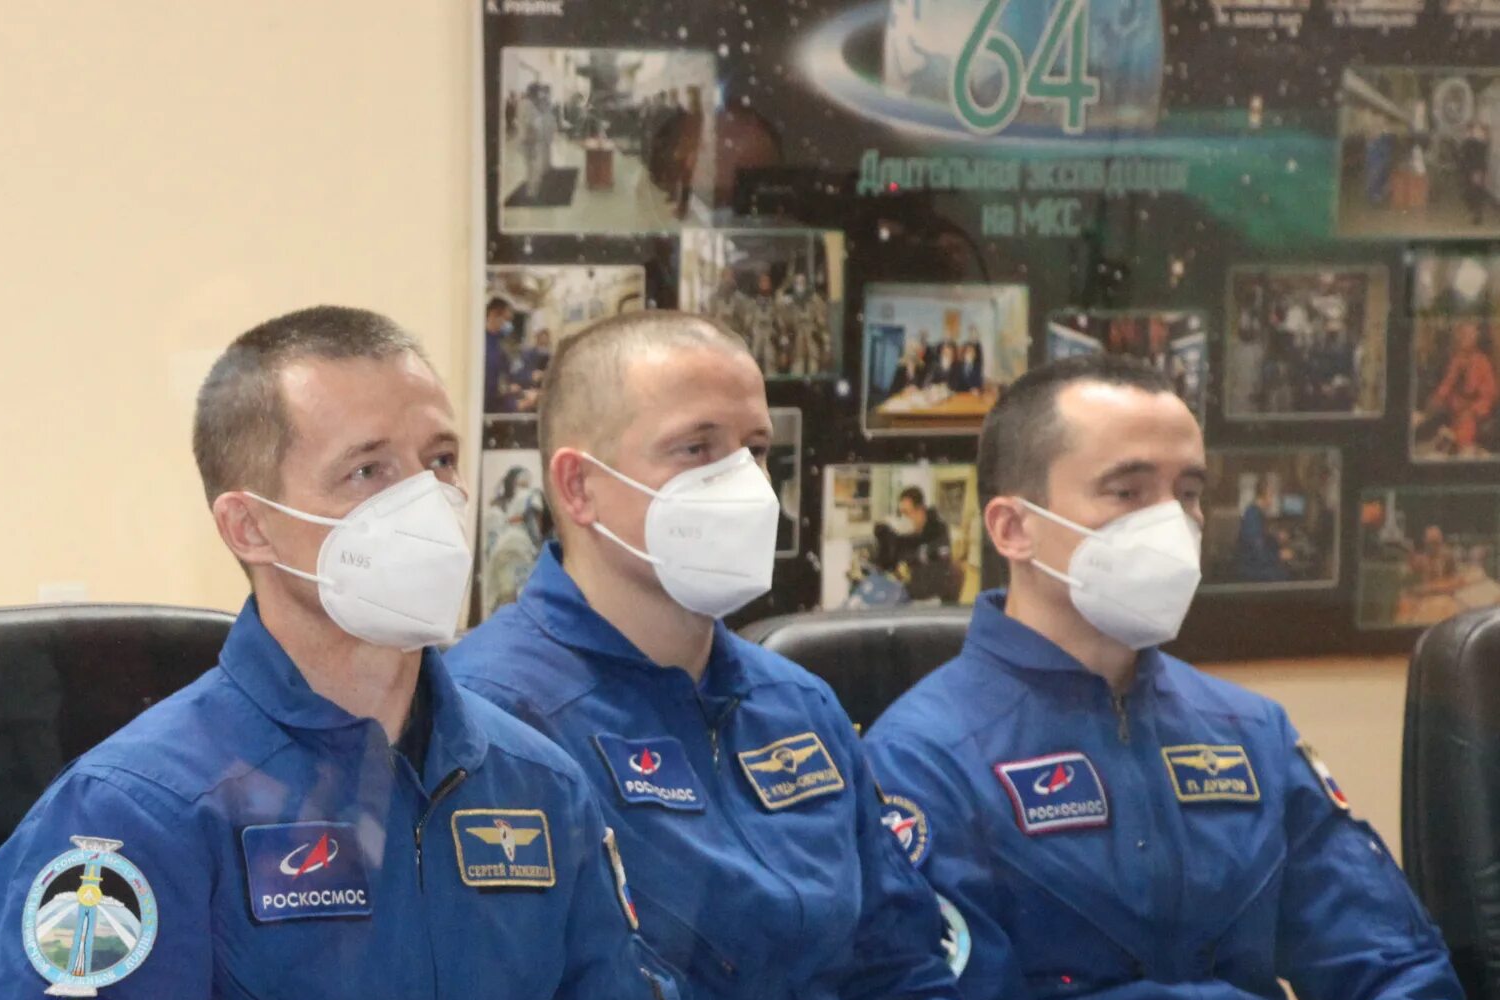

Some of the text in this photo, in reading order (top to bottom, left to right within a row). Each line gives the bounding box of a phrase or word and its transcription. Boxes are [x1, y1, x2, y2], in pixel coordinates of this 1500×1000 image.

[952, 0, 1101, 136] 64
[1020, 198, 1083, 237] МКС
[340, 550, 372, 570] KN95
[1028, 800, 1103, 820] РОСКОСМОС
[262, 889, 367, 910] РОСКОСМОС
